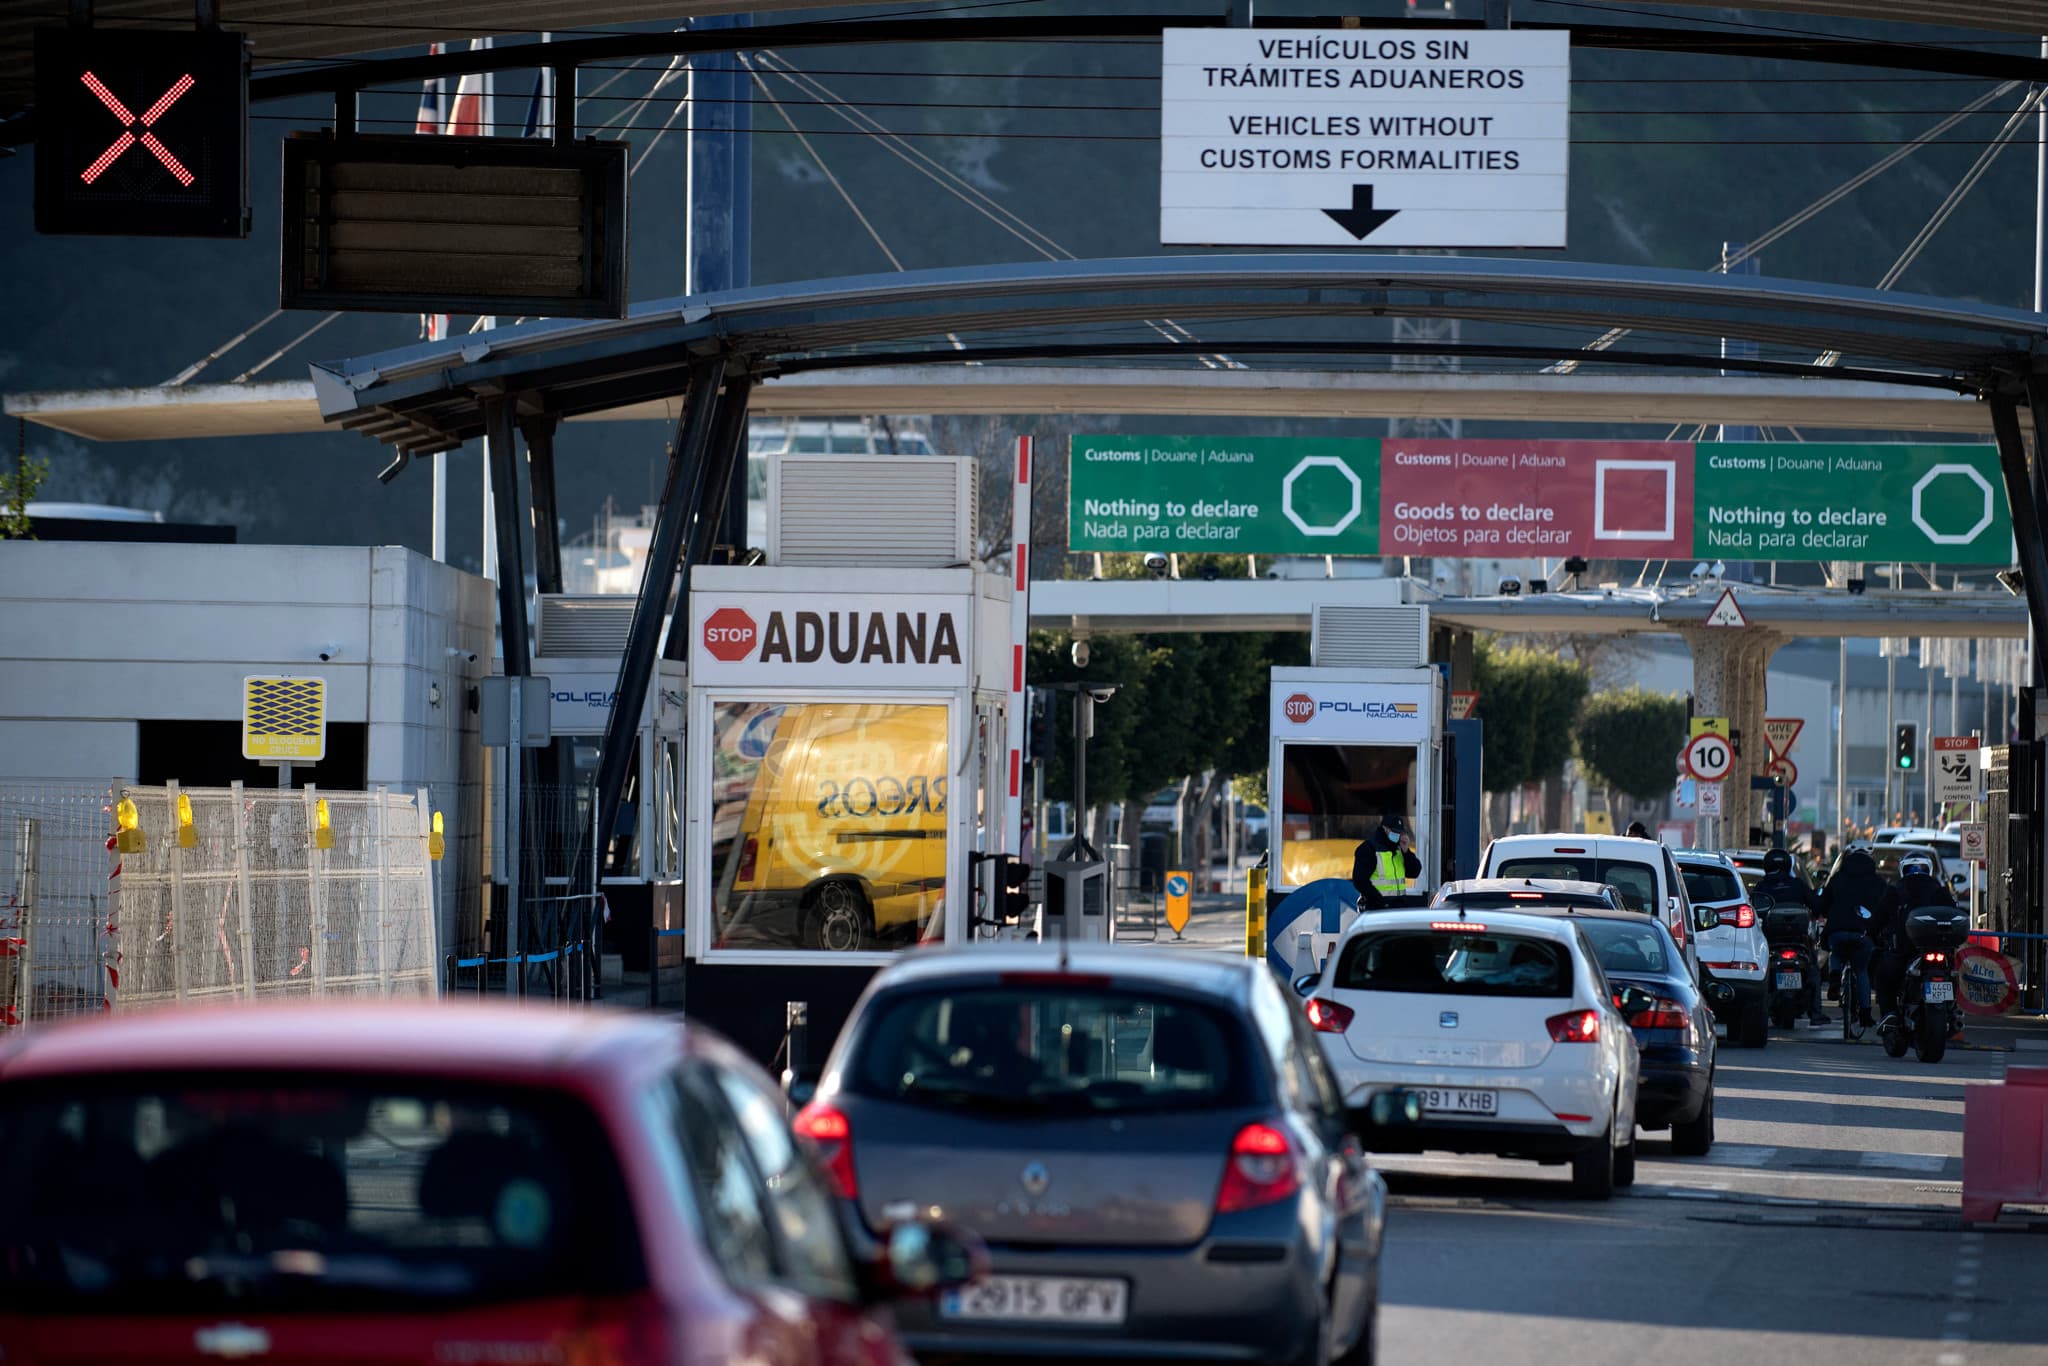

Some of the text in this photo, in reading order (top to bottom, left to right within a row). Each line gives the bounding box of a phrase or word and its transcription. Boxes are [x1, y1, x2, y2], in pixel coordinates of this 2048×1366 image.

[1259, 36, 1469, 60] VEHÍCULOS SIN
[1204, 64, 1524, 89] TRÁMITES ADUANEROS
[1229, 116, 1494, 136] VEHICLES WITHOUT
[1200, 149, 1519, 170] CUSTOMS FORMALITIES
[1085, 448, 1254, 463] Customs Douane Aduana
[1395, 451, 1566, 467] Customs Douane Aduana
[1710, 455, 1883, 471] Customs Douane Aduana
[1085, 498, 1259, 520] Nothing to declare
[1395, 502, 1554, 522] Goods to declare
[1709, 506, 1887, 528] Nothing to declare
[1085, 521, 1241, 543] Nada para declarar
[1394, 523, 1572, 547] Objetos para declarar
[1709, 529, 1869, 551] Nada para declarar
[707, 611, 962, 665] STOP ADUANA
[1287, 701, 1313, 716] STOP
[1767, 723, 1792, 733] GIVE
[1771, 733, 1790, 741] WAY
[251, 735, 265, 745] NO
[1944, 738, 1969, 747] STOP
[1696, 746, 1725, 768] 10
[1943, 784, 1973, 792] PASSPORT
[1944, 793, 1972, 801] CONTROL
[1458, 1093, 1493, 1110] KHB
